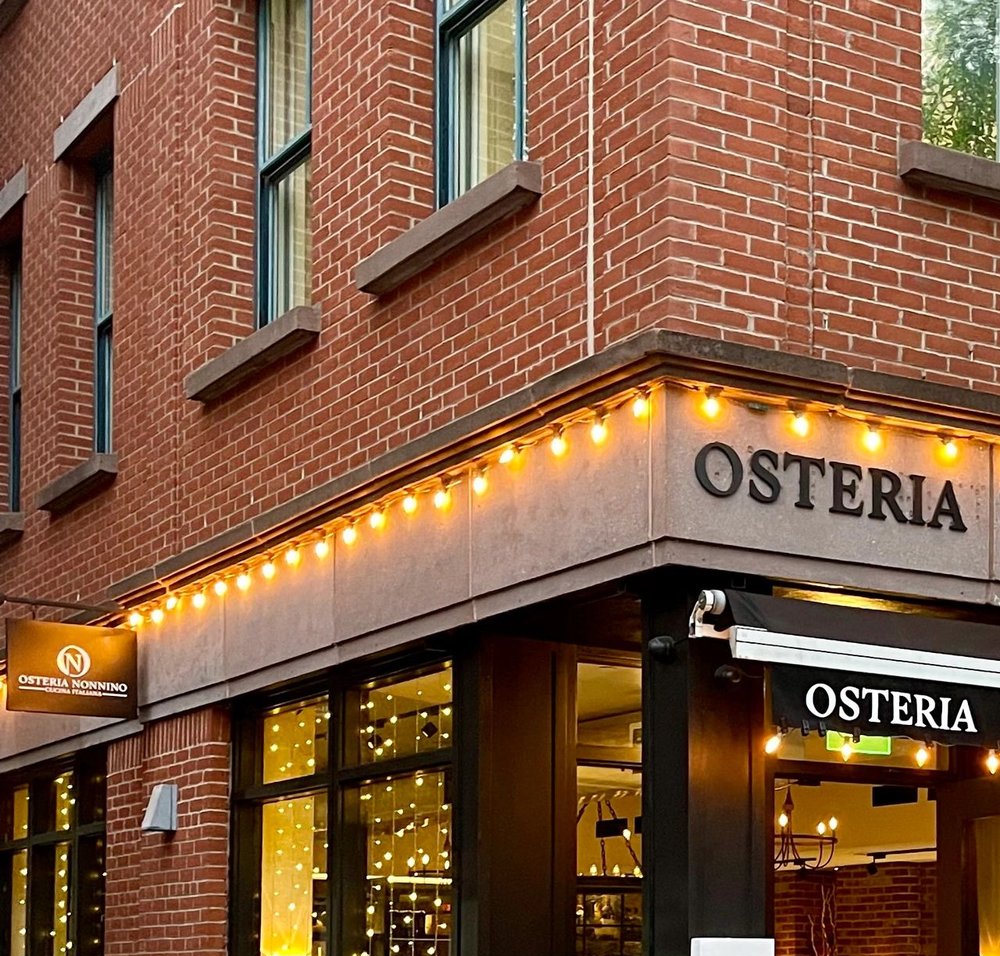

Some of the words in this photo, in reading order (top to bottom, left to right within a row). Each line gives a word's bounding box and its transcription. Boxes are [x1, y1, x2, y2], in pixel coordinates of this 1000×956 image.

[695, 441, 967, 533] OSTERIA
[18, 674, 69, 687] OSTERIA
[71, 680, 128, 692] NONNINO
[805, 683, 978, 733] OSTERIA
